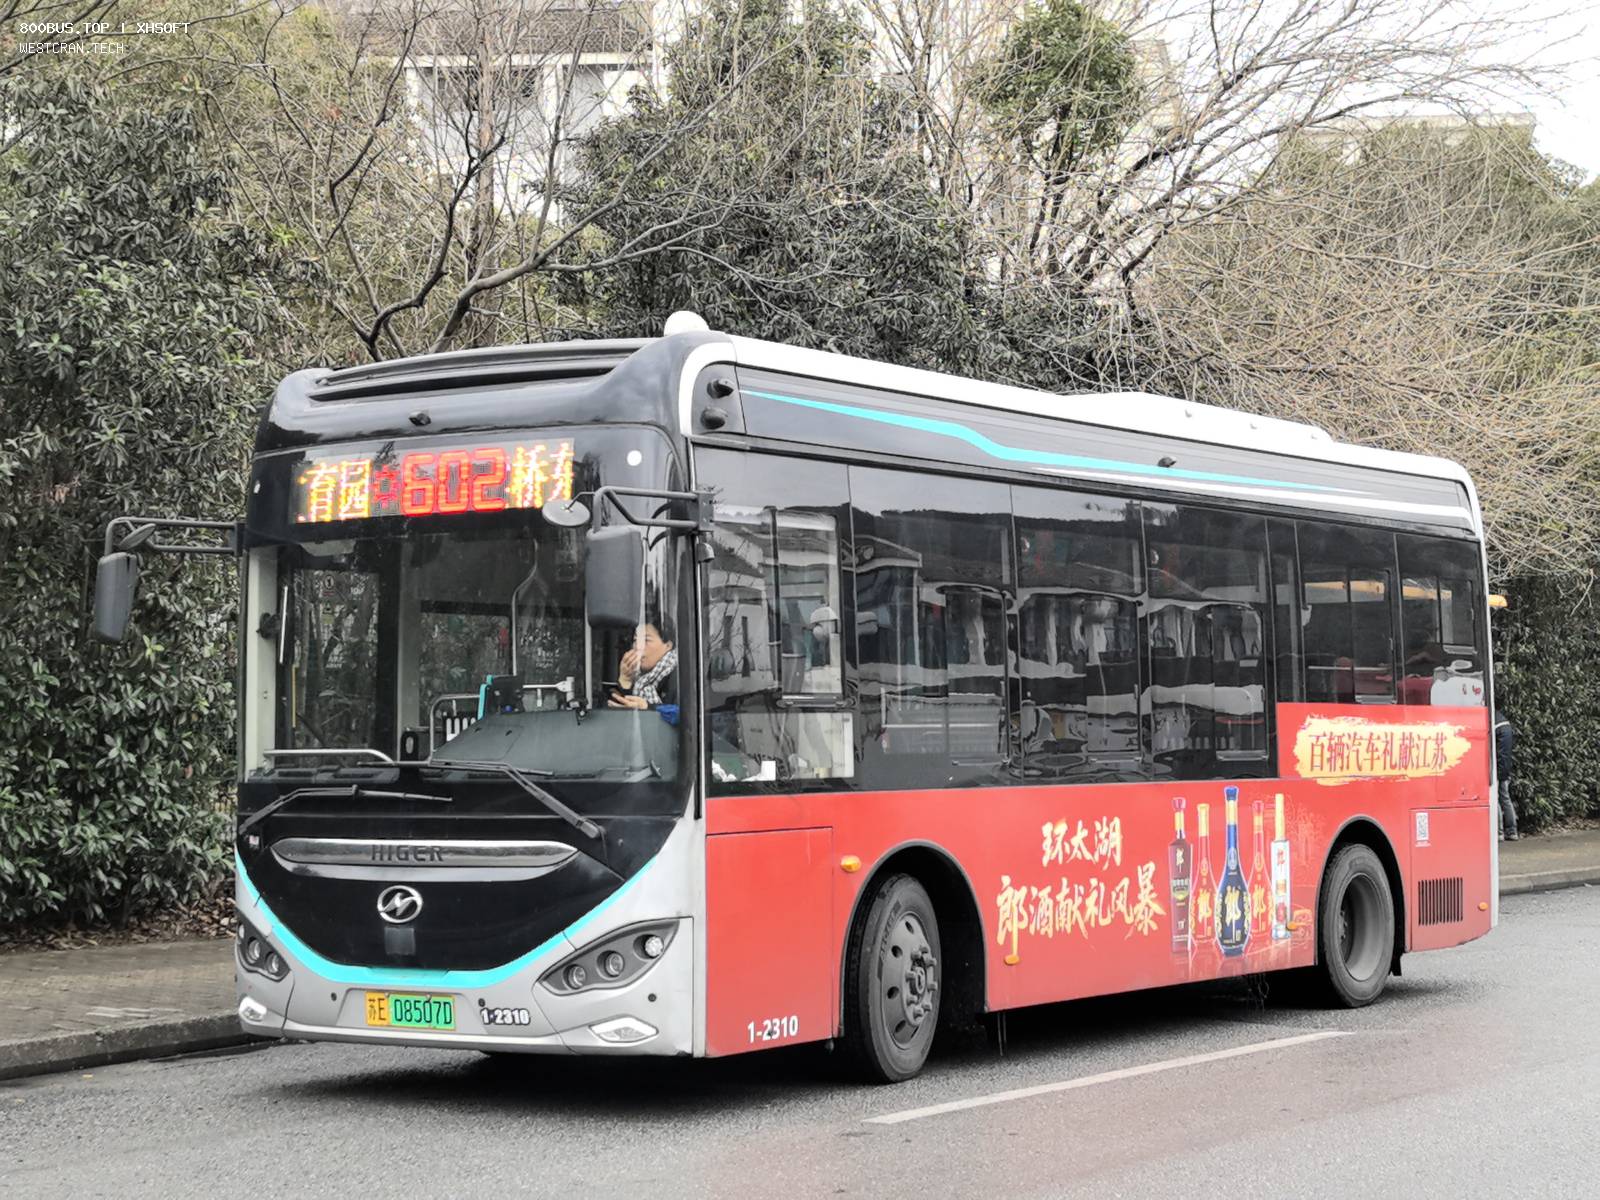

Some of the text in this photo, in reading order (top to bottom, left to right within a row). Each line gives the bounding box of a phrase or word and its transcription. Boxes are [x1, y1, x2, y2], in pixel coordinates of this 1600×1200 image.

[402, 447, 507, 517] 602
[1308, 731, 1448, 773] 百辆汽车礼献江苏
[371, 844, 444, 862] HIGER
[1041, 816, 1123, 871] 环太湖
[996, 861, 1167, 956] 郎酒献礼风暴
[747, 1014, 799, 1044] 1-2310
